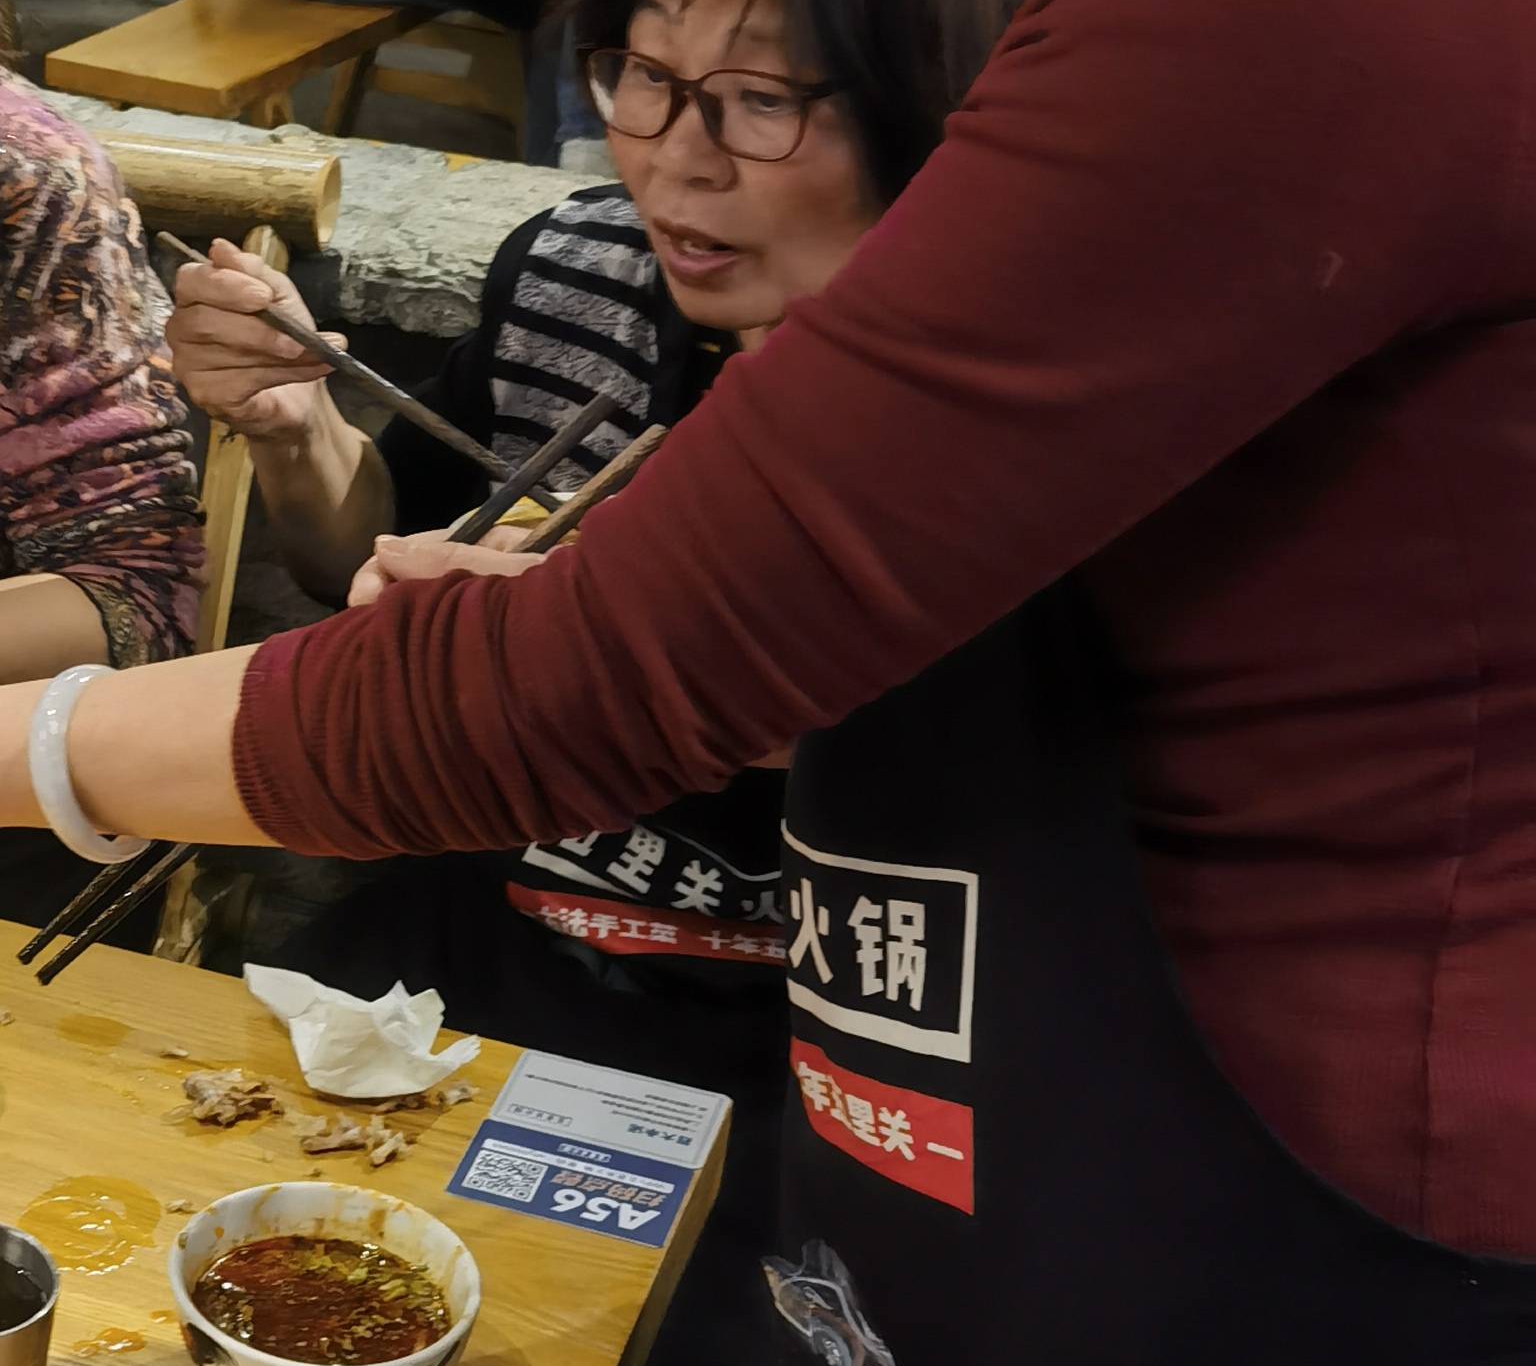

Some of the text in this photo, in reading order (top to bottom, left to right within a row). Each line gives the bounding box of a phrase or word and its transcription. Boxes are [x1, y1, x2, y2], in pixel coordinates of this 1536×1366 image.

[788, 876, 927, 1012] 火锅
[550, 1169, 667, 1208] 扫码点餐
[550, 1188, 661, 1231] A56
